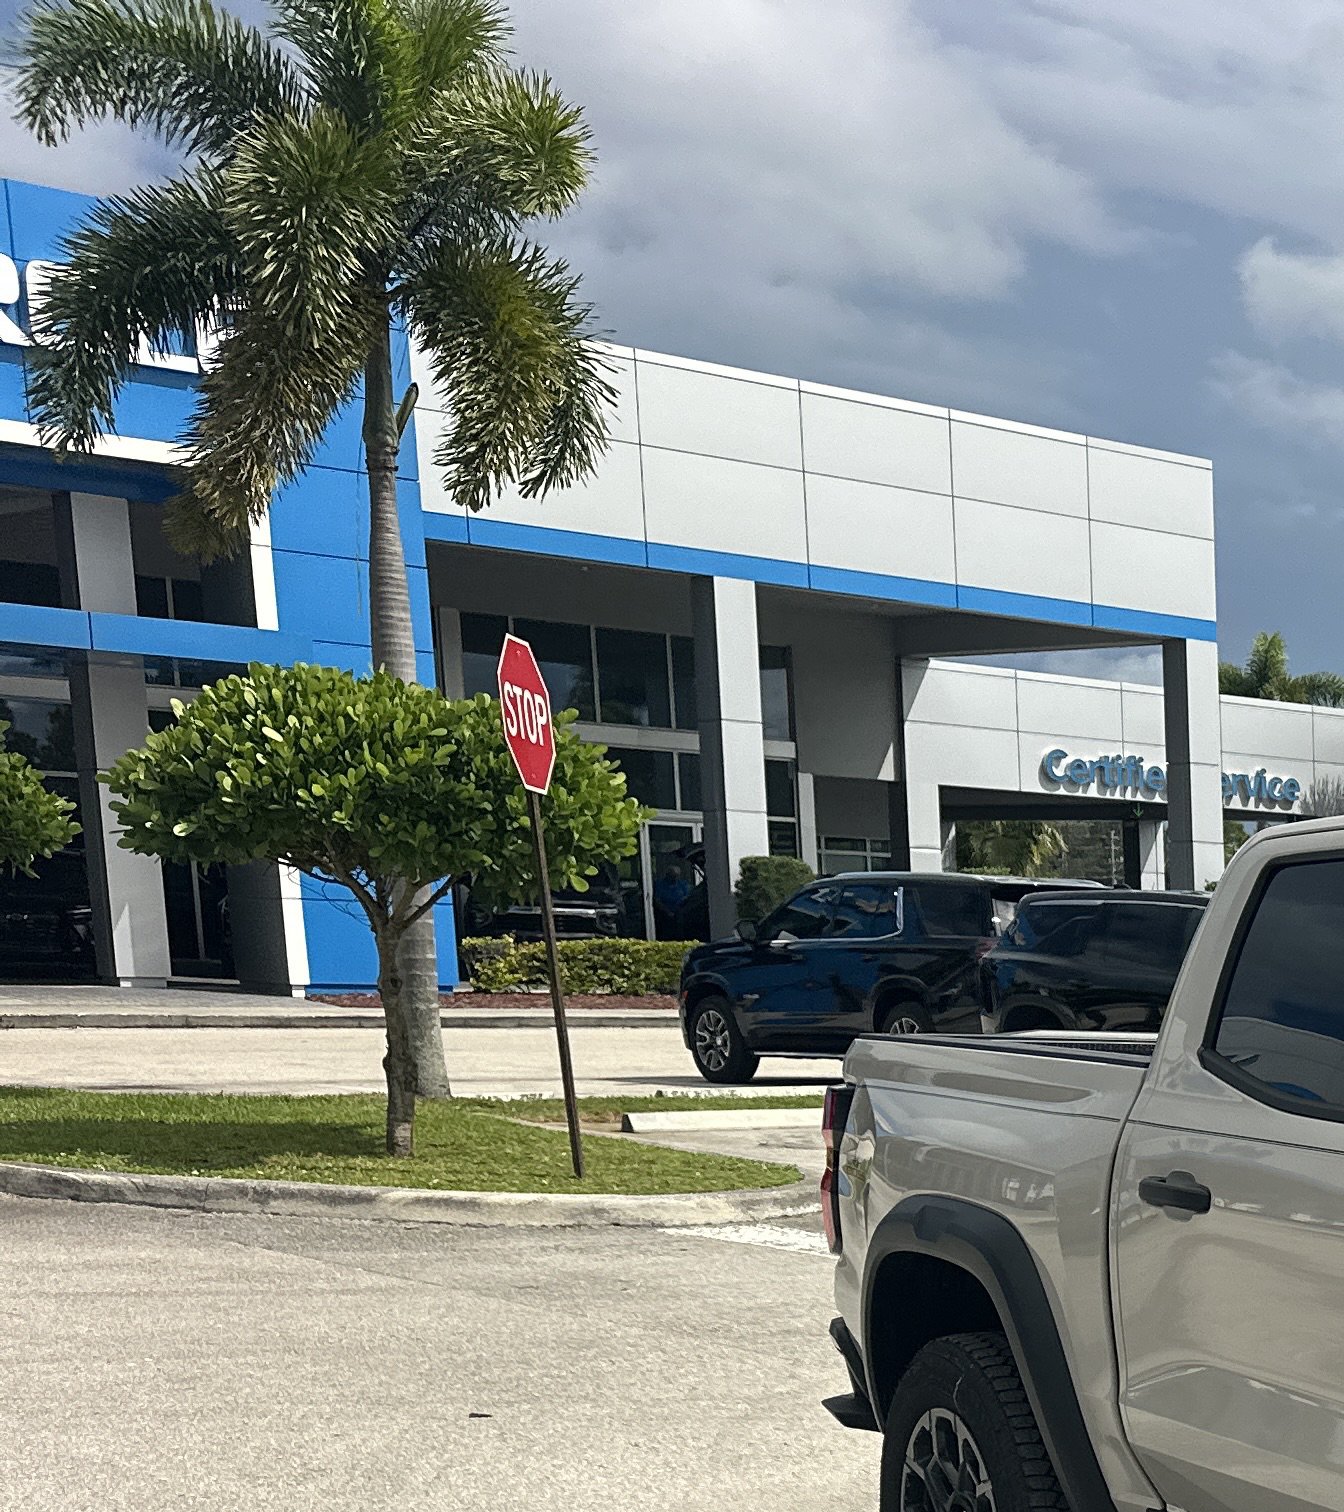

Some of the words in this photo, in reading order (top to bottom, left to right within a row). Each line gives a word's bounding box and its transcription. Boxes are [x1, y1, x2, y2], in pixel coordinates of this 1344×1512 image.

[504, 682, 547, 746] STOP
[1046, 749, 1167, 790] Certifie
[1221, 768, 1300, 801] ervice
